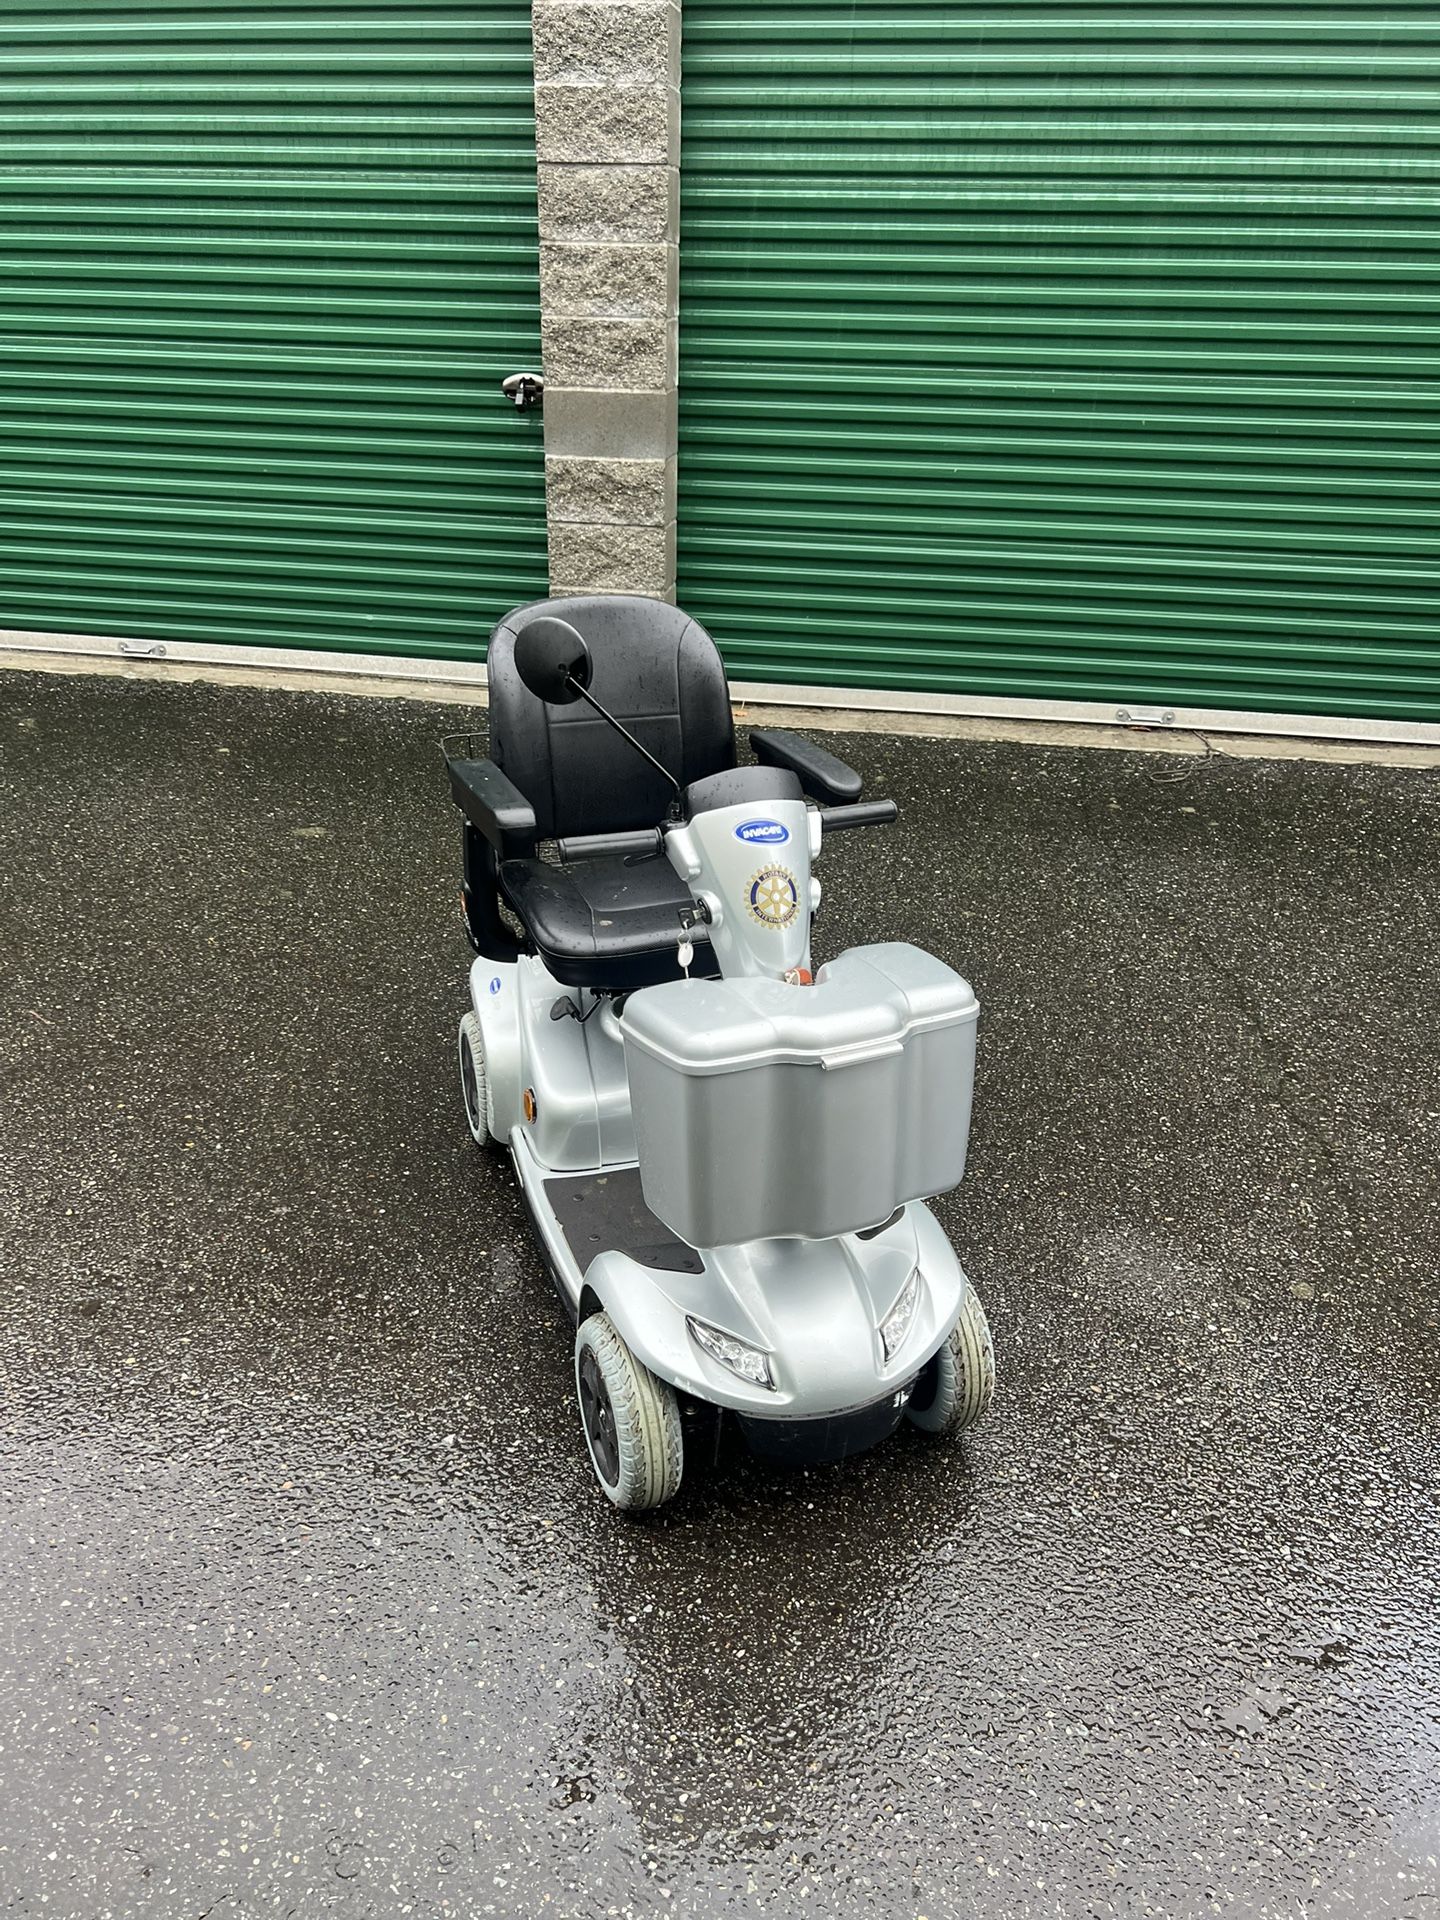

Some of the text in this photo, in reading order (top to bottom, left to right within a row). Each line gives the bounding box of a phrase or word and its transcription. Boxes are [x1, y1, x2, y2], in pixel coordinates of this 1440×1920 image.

[743, 825, 782, 839] INVACARE
[763, 870, 787, 880] ROTARY
[755, 907, 796, 923] INTERNATIONAL
